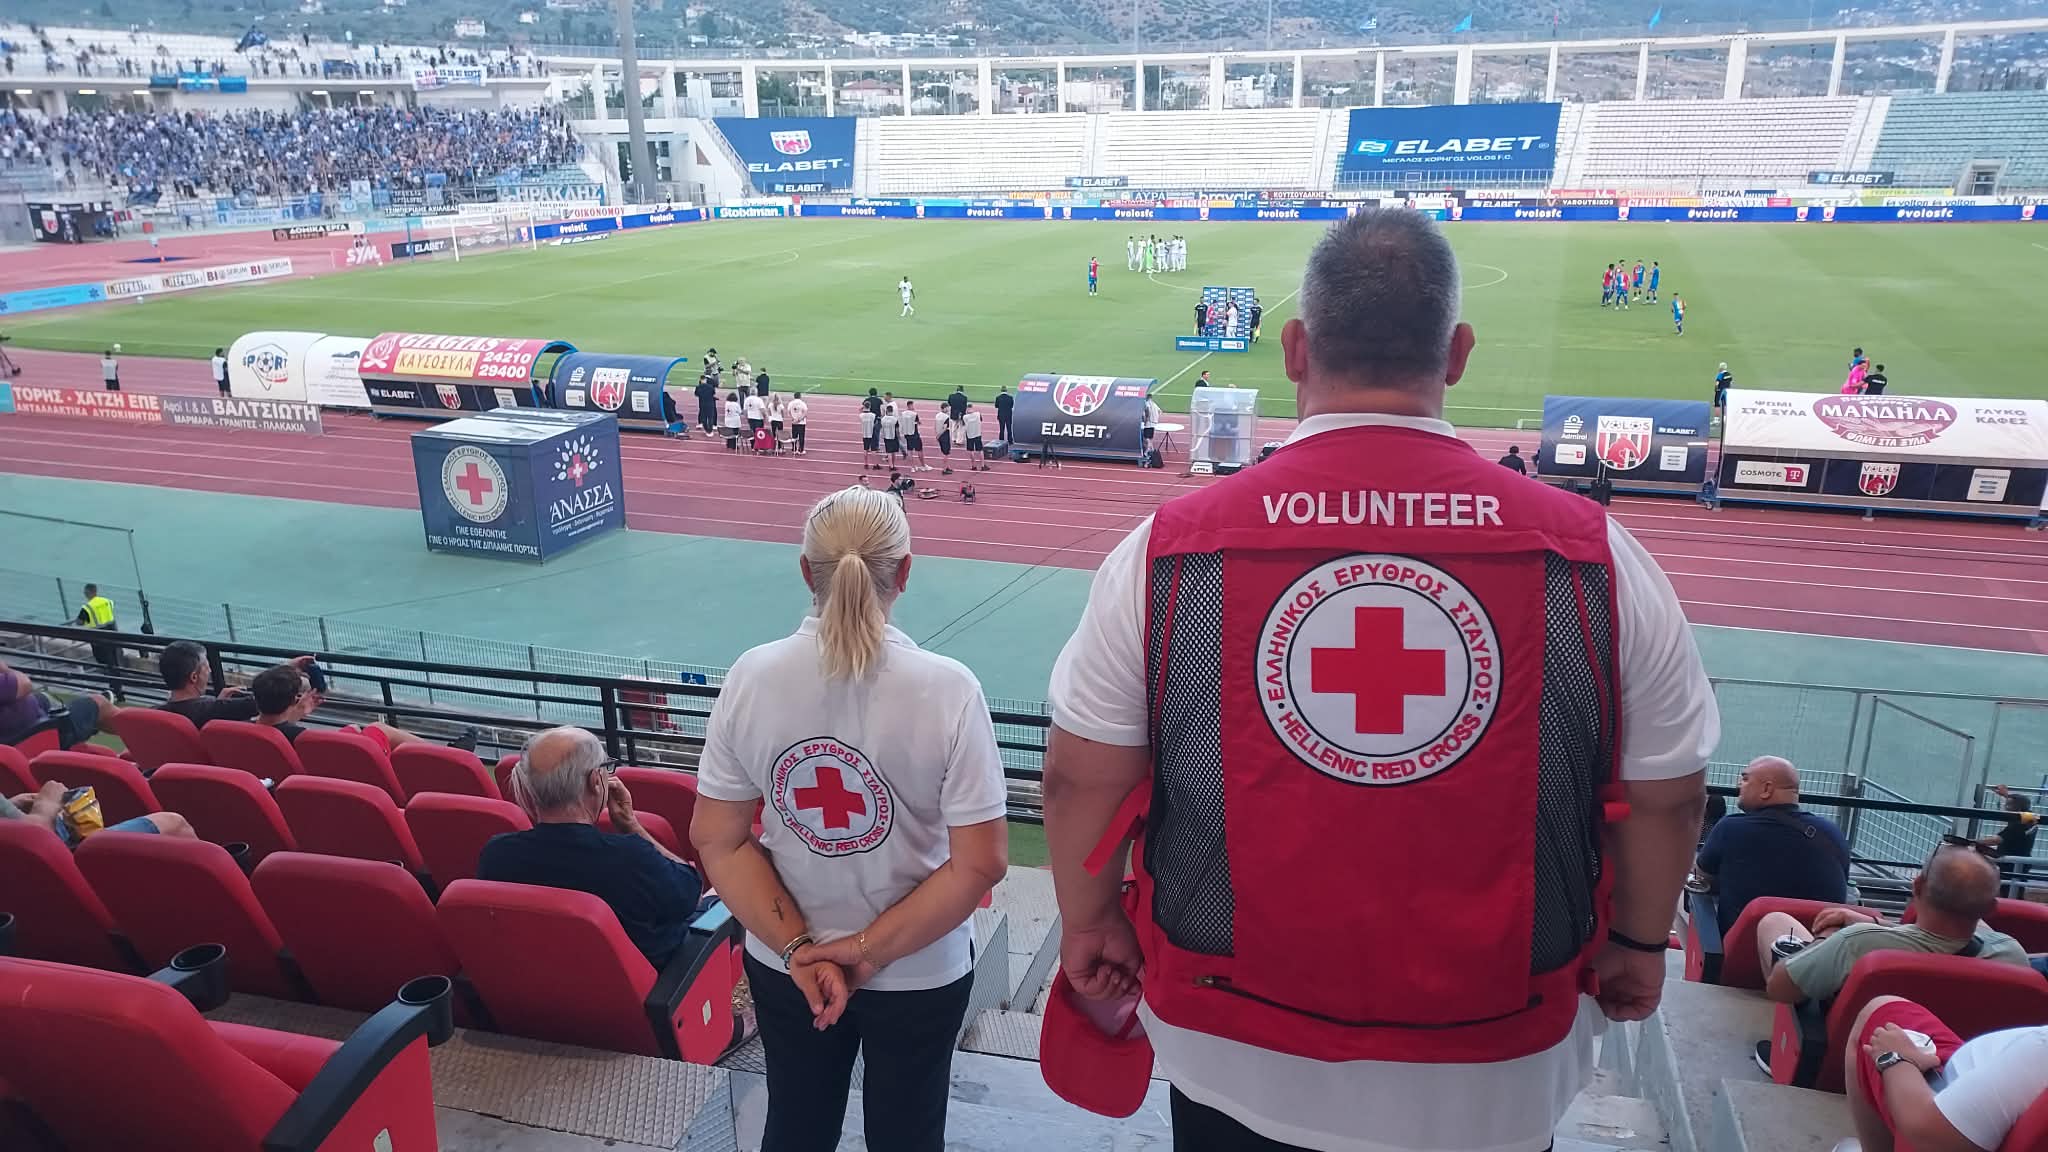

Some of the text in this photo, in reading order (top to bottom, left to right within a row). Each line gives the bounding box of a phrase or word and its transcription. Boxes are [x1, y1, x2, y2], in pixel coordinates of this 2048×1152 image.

[1394, 136, 1541, 154] ELABET
[748, 158, 843, 172] ELABET
[1083, 178, 1121, 186] ELABET
[1831, 174, 1881, 184] ELABET
[516, 185, 601, 200] ΗΡΑΚΛΗΣ
[785, 184, 825, 193] ELABET
[1704, 190, 1741, 198] ΠΡΙΣΜΑ
[841, 207, 876, 216] #volosfc
[967, 208, 1003, 216] #volosfc
[1115, 209, 1154, 218] #volosfc
[1258, 210, 1300, 218] #volosfc
[1515, 209, 1562, 218] #volosfc
[1688, 210, 1738, 218] #volosfc
[1897, 208, 1953, 218] #volosfc
[346, 246, 380, 264] SYM
[398, 352, 474, 372] ΚΑΥΣΟΞΥΛΑ
[483, 352, 532, 364] 24210
[478, 365, 526, 378] 29400
[76, 390, 124, 407] ΧΑΤΖΗ
[128, 394, 160, 410] ΕΠΕ
[381, 389, 415, 400] ELABET
[212, 399, 318, 422] ΒΑΛΤΣΙΩΤΗ
[1740, 408, 1766, 416] ΣΤΑ
[1821, 404, 1952, 422] ΜΑΝΔΗΛΑ
[174, 414, 306, 433] ΜΑΡΜΑΡΑ ΓΡΑΝΙΤΕΣ ΠΛΑΚΑΚΙΑ
[1976, 416, 2028, 426] ΚΑΦΕΣ
[1041, 422, 1107, 438] ELABET
[1880, 437, 1896, 446] ΣΤΑ
[1740, 470, 1782, 478] COSMOTE
[1263, 490, 1504, 526] VOLUNTEER
[470, 528, 507, 540] ΕΘΕΛΟΝΤΗΣ
[450, 538, 470, 547] ΗΡΩΑΣ
[470, 539, 482, 549] ΤΗΣ
[514, 545, 538, 556] ΠΟΡΤΑΣ
[1266, 562, 1493, 704] ΕΛΛΗΝΙΚΟΣ ΕΡΥΘΡΟΣ ΣΤΑΥΡΟΣ
[1278, 711, 1482, 780] HELLENIC RED CROSS
[802, 743, 860, 767] ΕΡΥΘΡΟΣ
[863, 769, 888, 822] ΣΤΑΥΡΟΣ
[786, 816, 885, 852] HELLENIC RED CROSS
